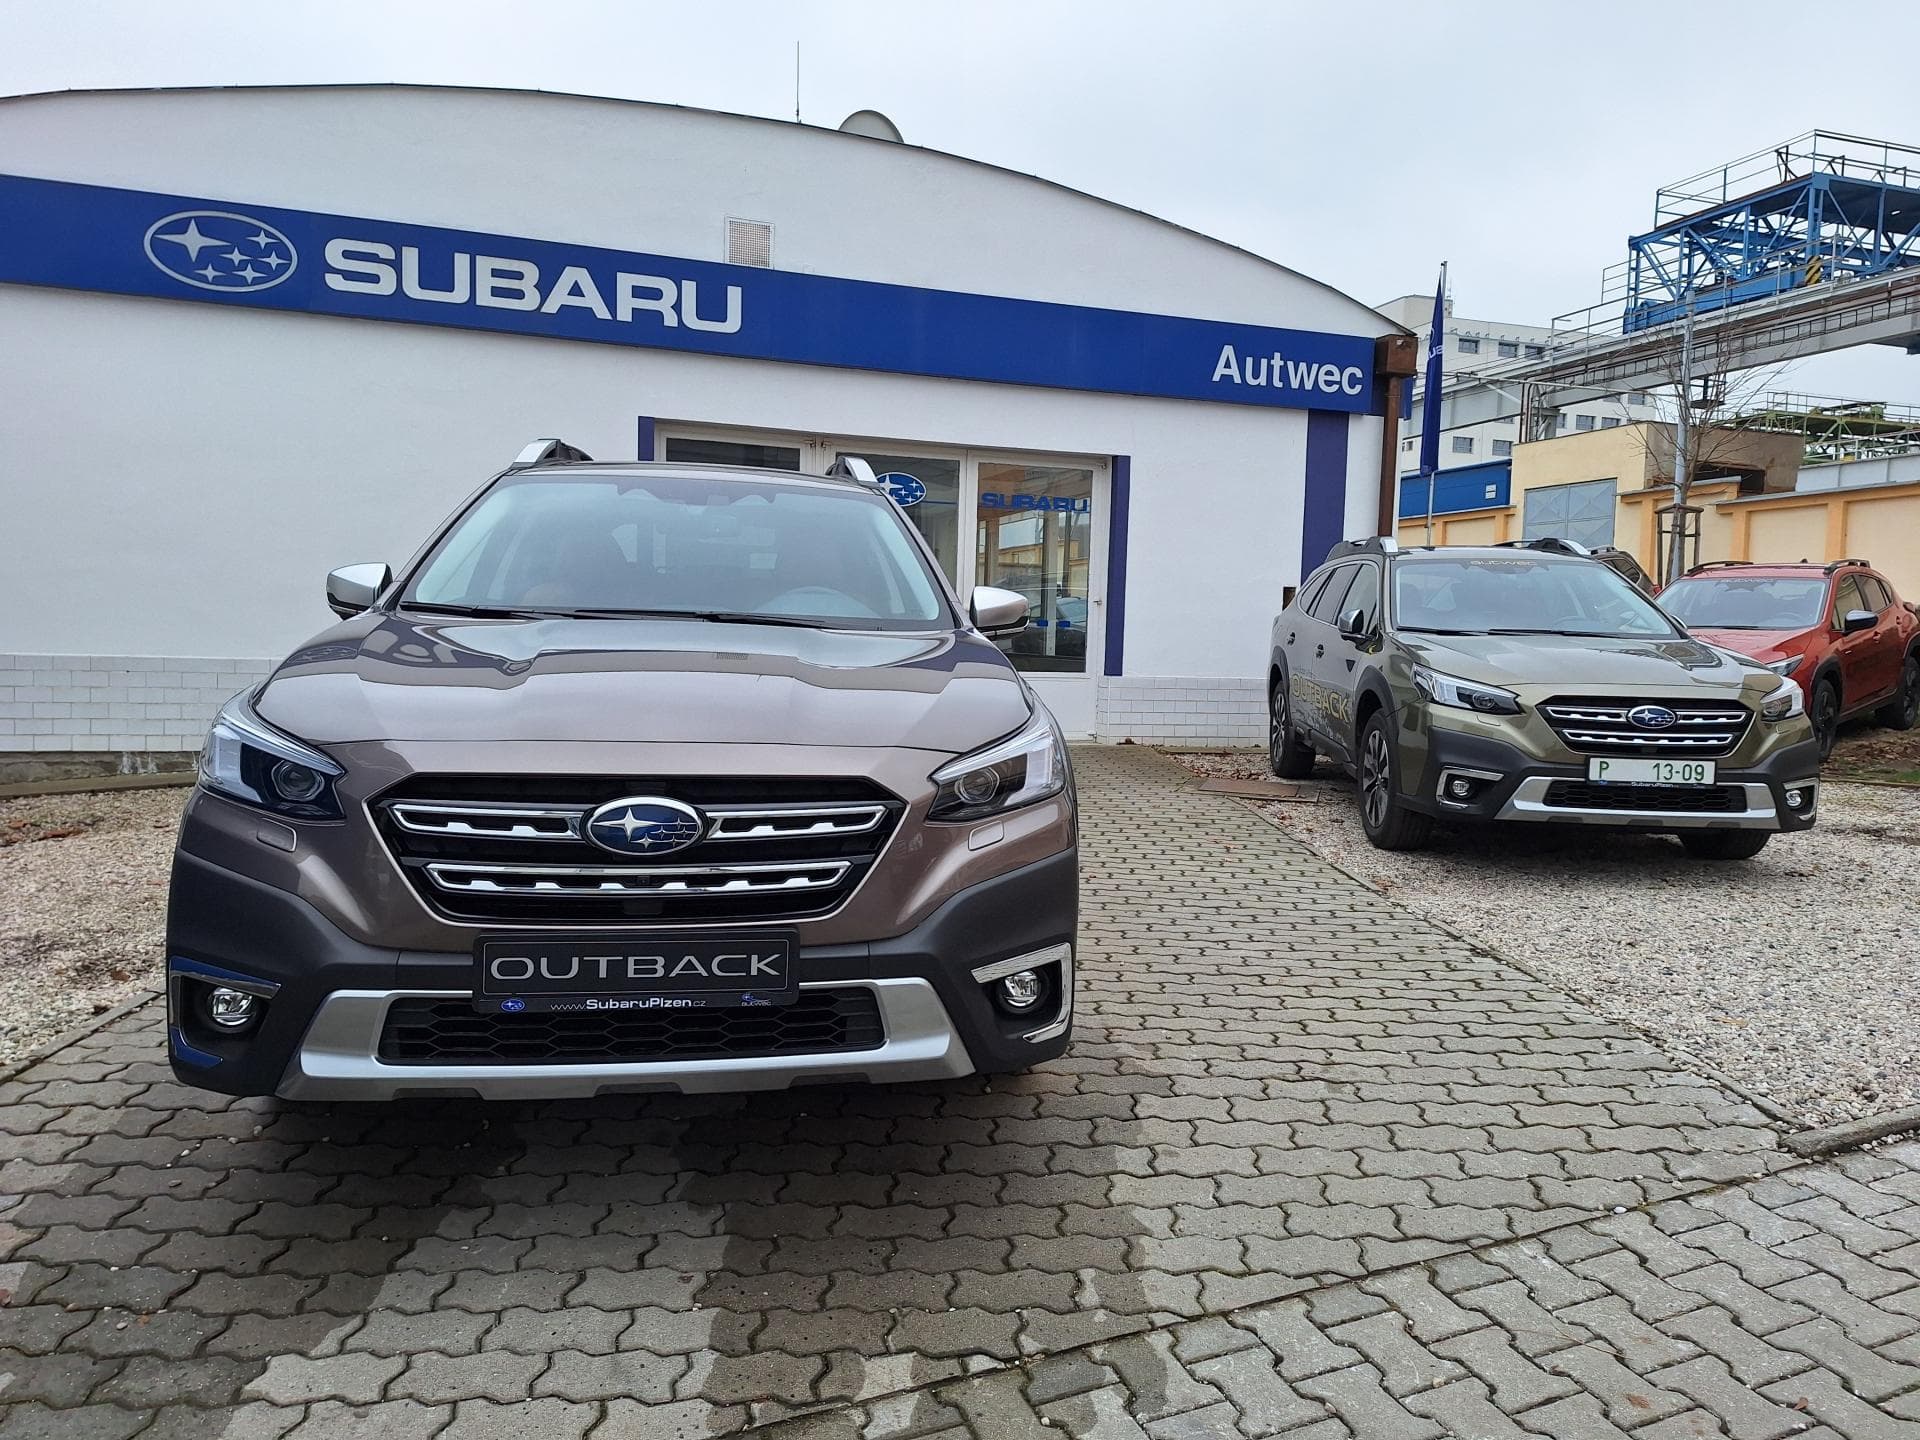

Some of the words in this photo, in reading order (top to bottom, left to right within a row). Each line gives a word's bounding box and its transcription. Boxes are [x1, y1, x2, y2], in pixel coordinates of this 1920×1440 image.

[324, 238, 743, 334] SUBARU
[1211, 345, 1364, 395] Autwec
[982, 492, 1088, 512] SUBARU
[1291, 673, 1350, 723] OUTBACK
[1599, 760, 1610, 779] P
[1653, 763, 1705, 782] 13-09
[490, 954, 781, 980] OUTBACK
